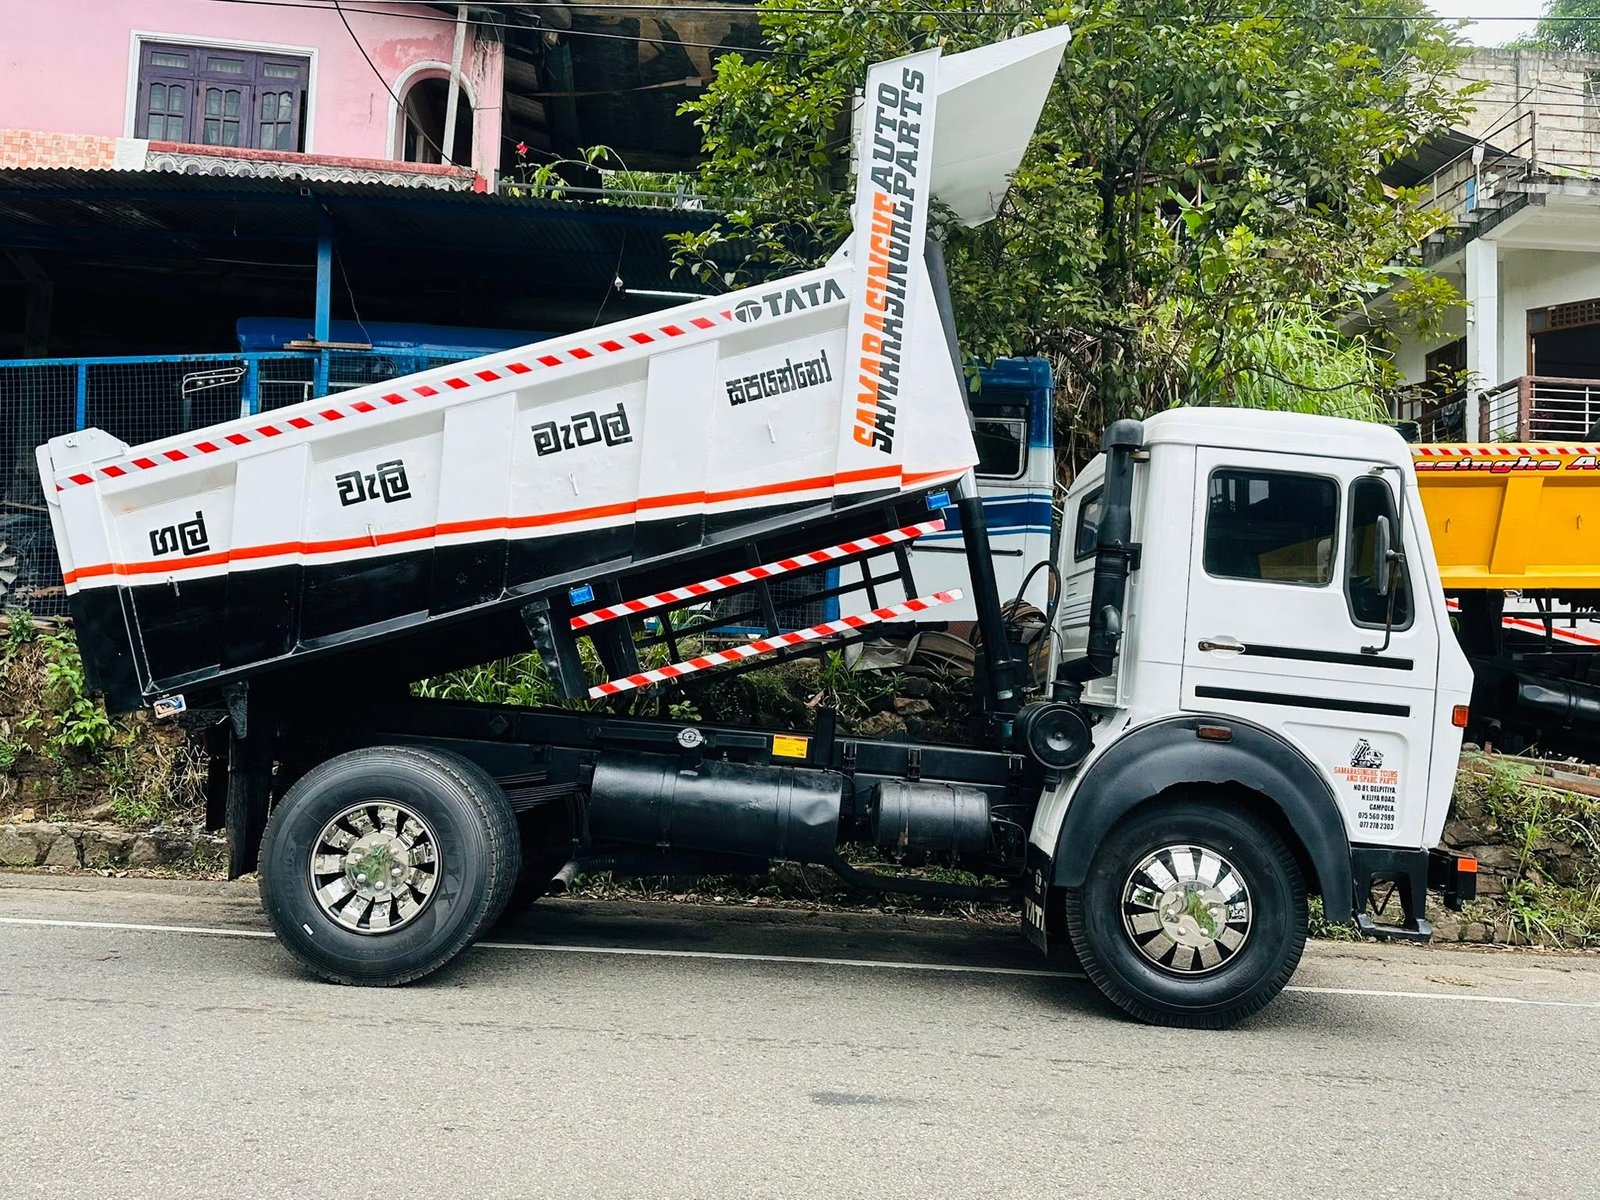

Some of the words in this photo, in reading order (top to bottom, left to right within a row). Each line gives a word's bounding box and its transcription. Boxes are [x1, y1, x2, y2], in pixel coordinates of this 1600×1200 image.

[871, 81, 900, 194] AUTO
[893, 66, 925, 201] PARTS
[761, 278, 846, 317] TATA
[853, 191, 914, 455] SAMARASINGHE
[530, 402, 633, 457] මැටල්
[335, 459, 412, 507] වැලි
[149, 510, 210, 556] ගල්
[1333, 766, 1378, 776] SAMARASINGHE
[1379, 769, 1398, 778] TOURS
[1346, 774, 1358, 782] AND
[1359, 775, 1378, 784] SPARE
[1379, 777, 1398, 785] PARTS
[1357, 811, 1368, 819] 075
[1380, 822, 1394, 831] 2303
